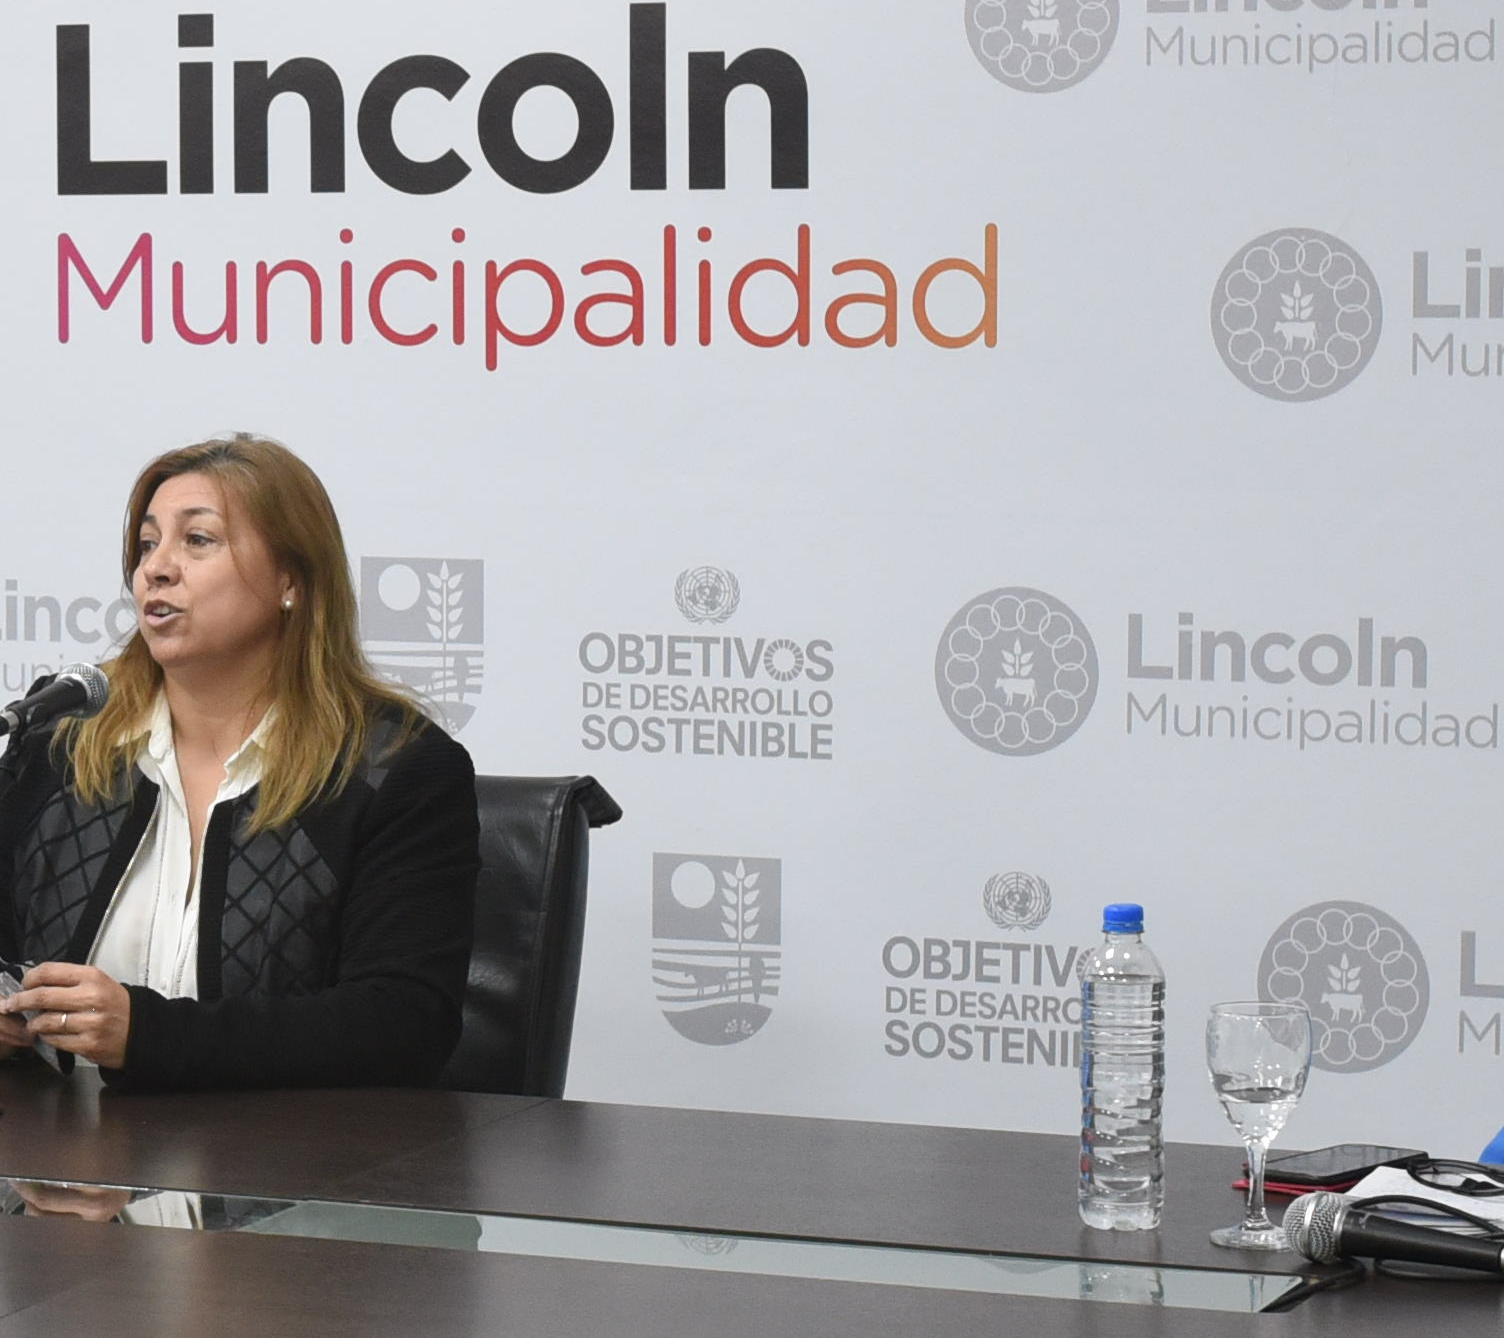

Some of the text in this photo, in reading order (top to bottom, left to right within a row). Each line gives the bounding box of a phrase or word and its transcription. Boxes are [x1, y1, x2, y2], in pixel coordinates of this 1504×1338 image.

[1147, 17, 1495, 73] Municipalidad
[57, 3, 808, 195] Lincoln
[58, 224, 997, 371] Municipalidad
[579, 633, 834, 682] OBJETIVOS
[1128, 613, 1427, 689] Lincoln
[583, 682, 833, 717] DE DESARROLLO
[1127, 692, 1498, 750] Municipalidad
[582, 714, 833, 760] SOSTENIBLE
[881, 935, 1095, 987] OBJETIV
[885, 986, 1083, 1022] DE DESARRO
